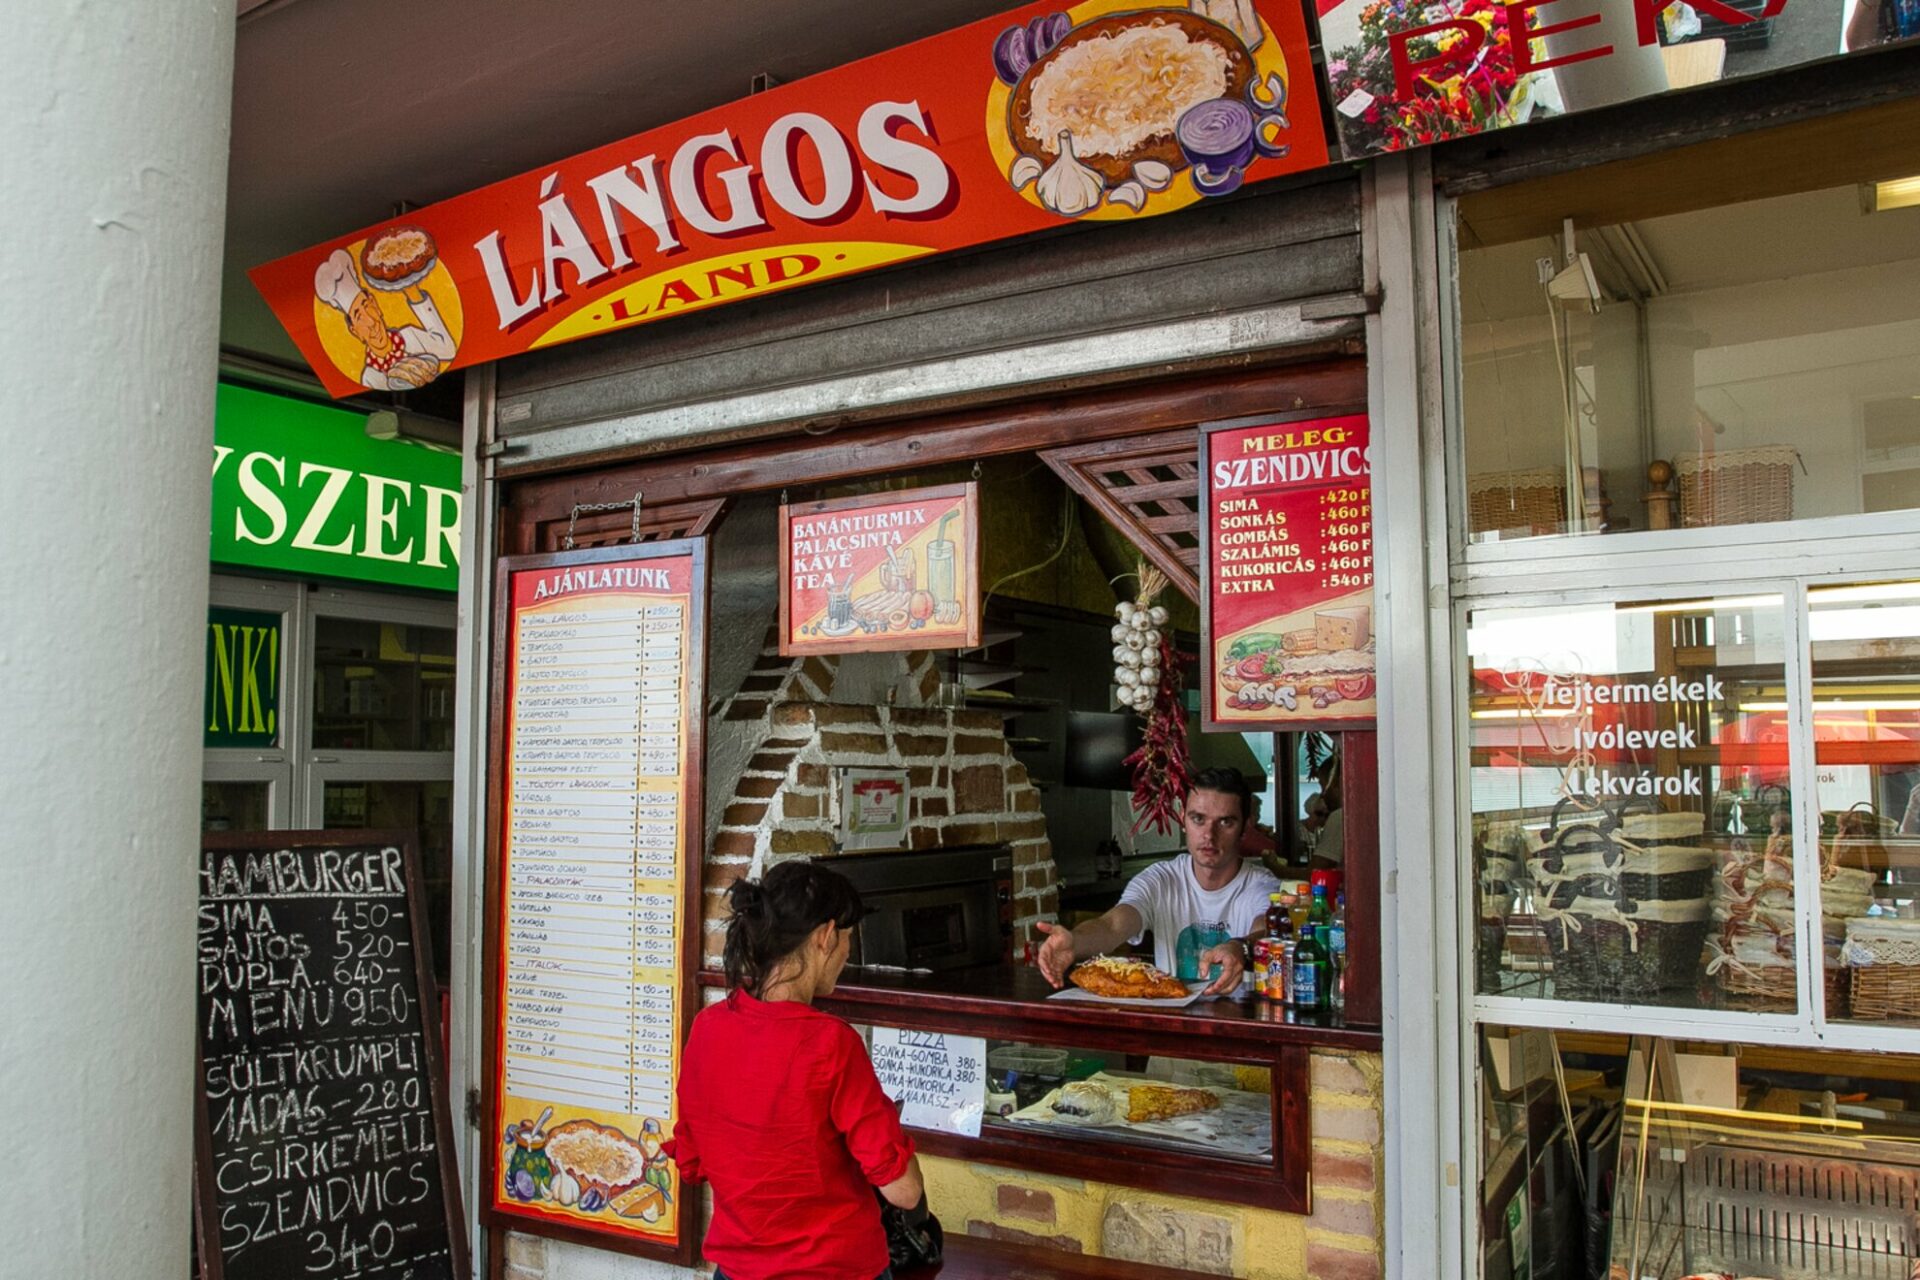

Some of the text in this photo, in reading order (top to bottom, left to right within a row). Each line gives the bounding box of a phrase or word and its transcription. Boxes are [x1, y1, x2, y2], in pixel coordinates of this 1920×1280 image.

[474, 99, 955, 332] LÁNGOS
[609, 253, 823, 323] LAND
[1243, 427, 1354, 453] MELEG-
[1219, 498, 1259, 513] SIMA
[1220, 510, 1286, 529] SONKÁS
[793, 508, 926, 539] BANÁNTURMIX
[1220, 527, 1289, 545] GOMBÁS
[793, 530, 903, 556] PALACSINTA
[1220, 543, 1300, 561] SZALÁMIS
[793, 550, 852, 573] KÁVÉ
[1220, 557, 1316, 577] KUKORICÁS
[534, 567, 671, 600] AJÁNLATUNK
[794, 572, 835, 591] TEA
[1221, 579, 1275, 594] EXTRA
[208, 623, 277, 735] NK!
[1543, 674, 1725, 710] Tejtermékek
[1574, 722, 1697, 750] Ivólevek
[1568, 768, 1703, 797] Lekvárok
[199, 848, 405, 897] HAMBURGER
[198, 901, 276, 934] SIMA
[198, 931, 311, 963] SAJTOS
[202, 959, 311, 994] DUPLA
[900, 1029, 946, 1049] PIZZA
[216, 1114, 435, 1194] CSIRKEMELL
[221, 1162, 430, 1252] SZENDVICS
